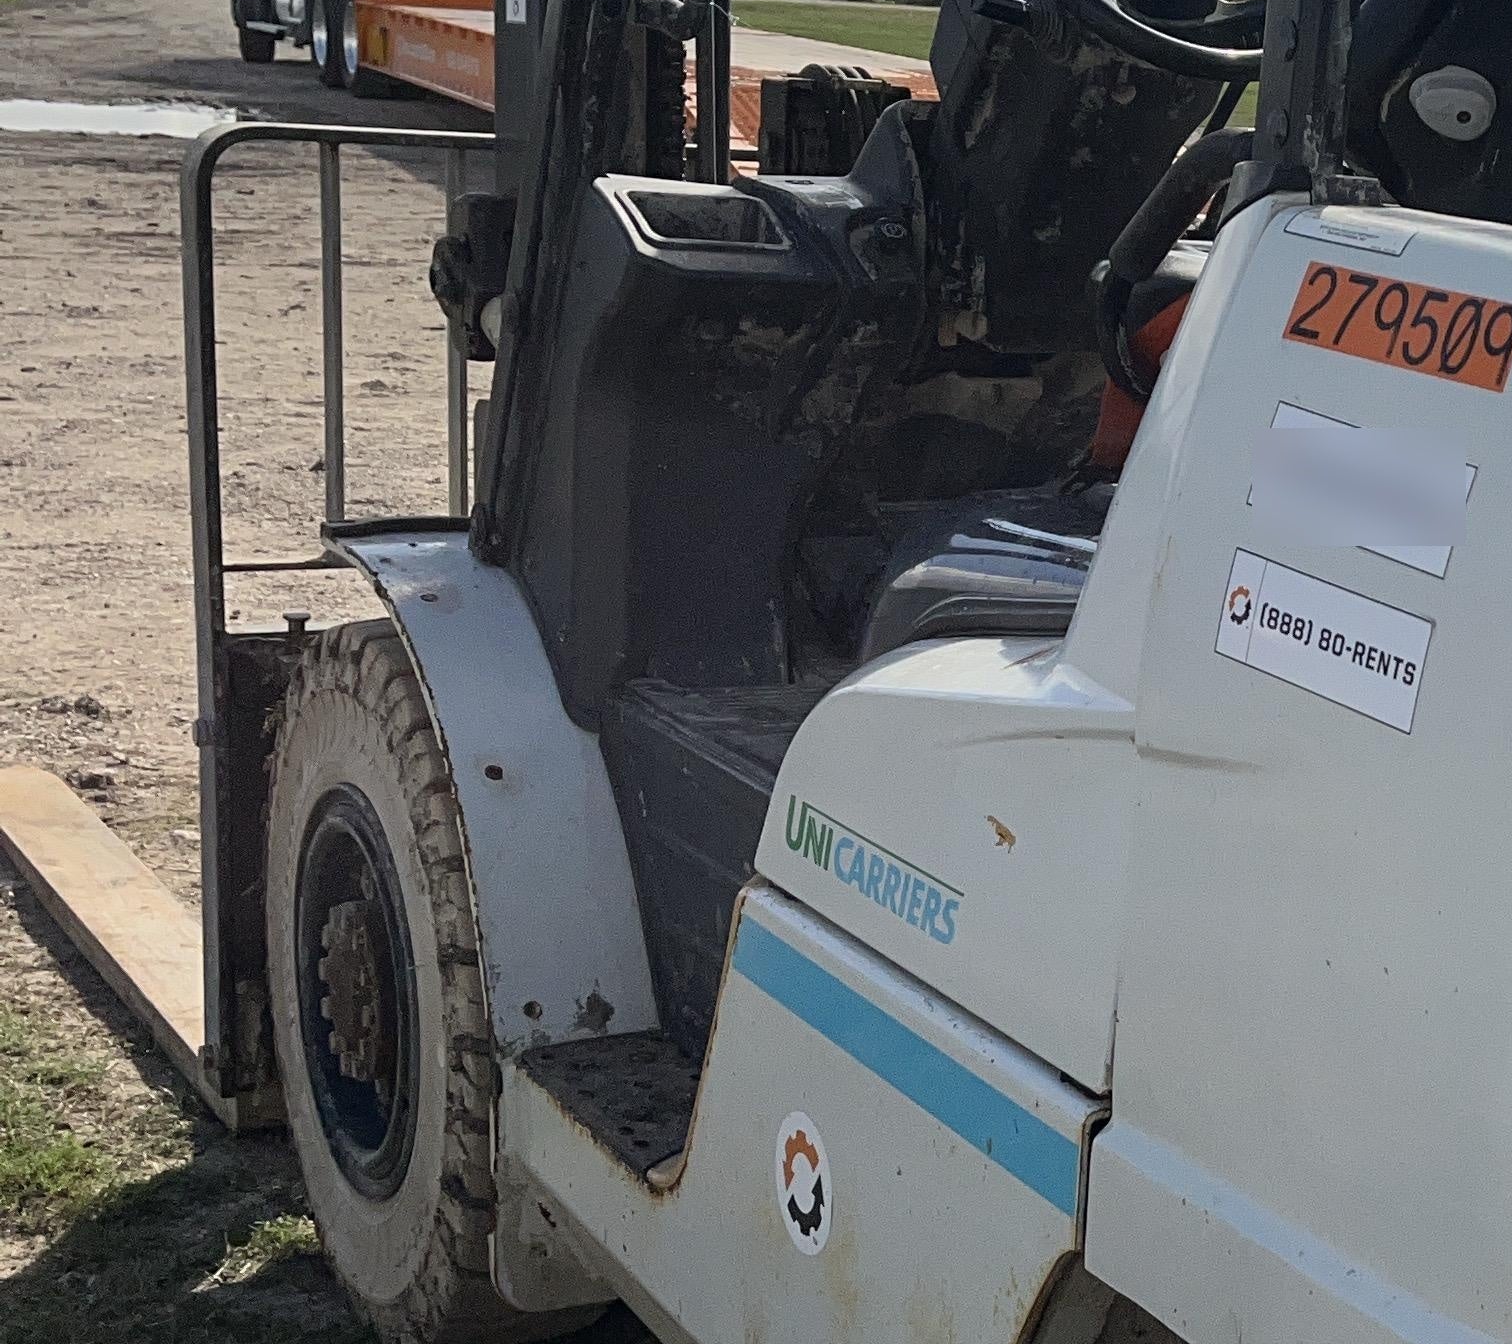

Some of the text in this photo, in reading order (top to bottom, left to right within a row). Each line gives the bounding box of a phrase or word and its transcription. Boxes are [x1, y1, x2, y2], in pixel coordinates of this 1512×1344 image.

[1259, 600, 1418, 688] (888) 80-RENTS
[785, 793, 965, 946] UNICARRIERS
